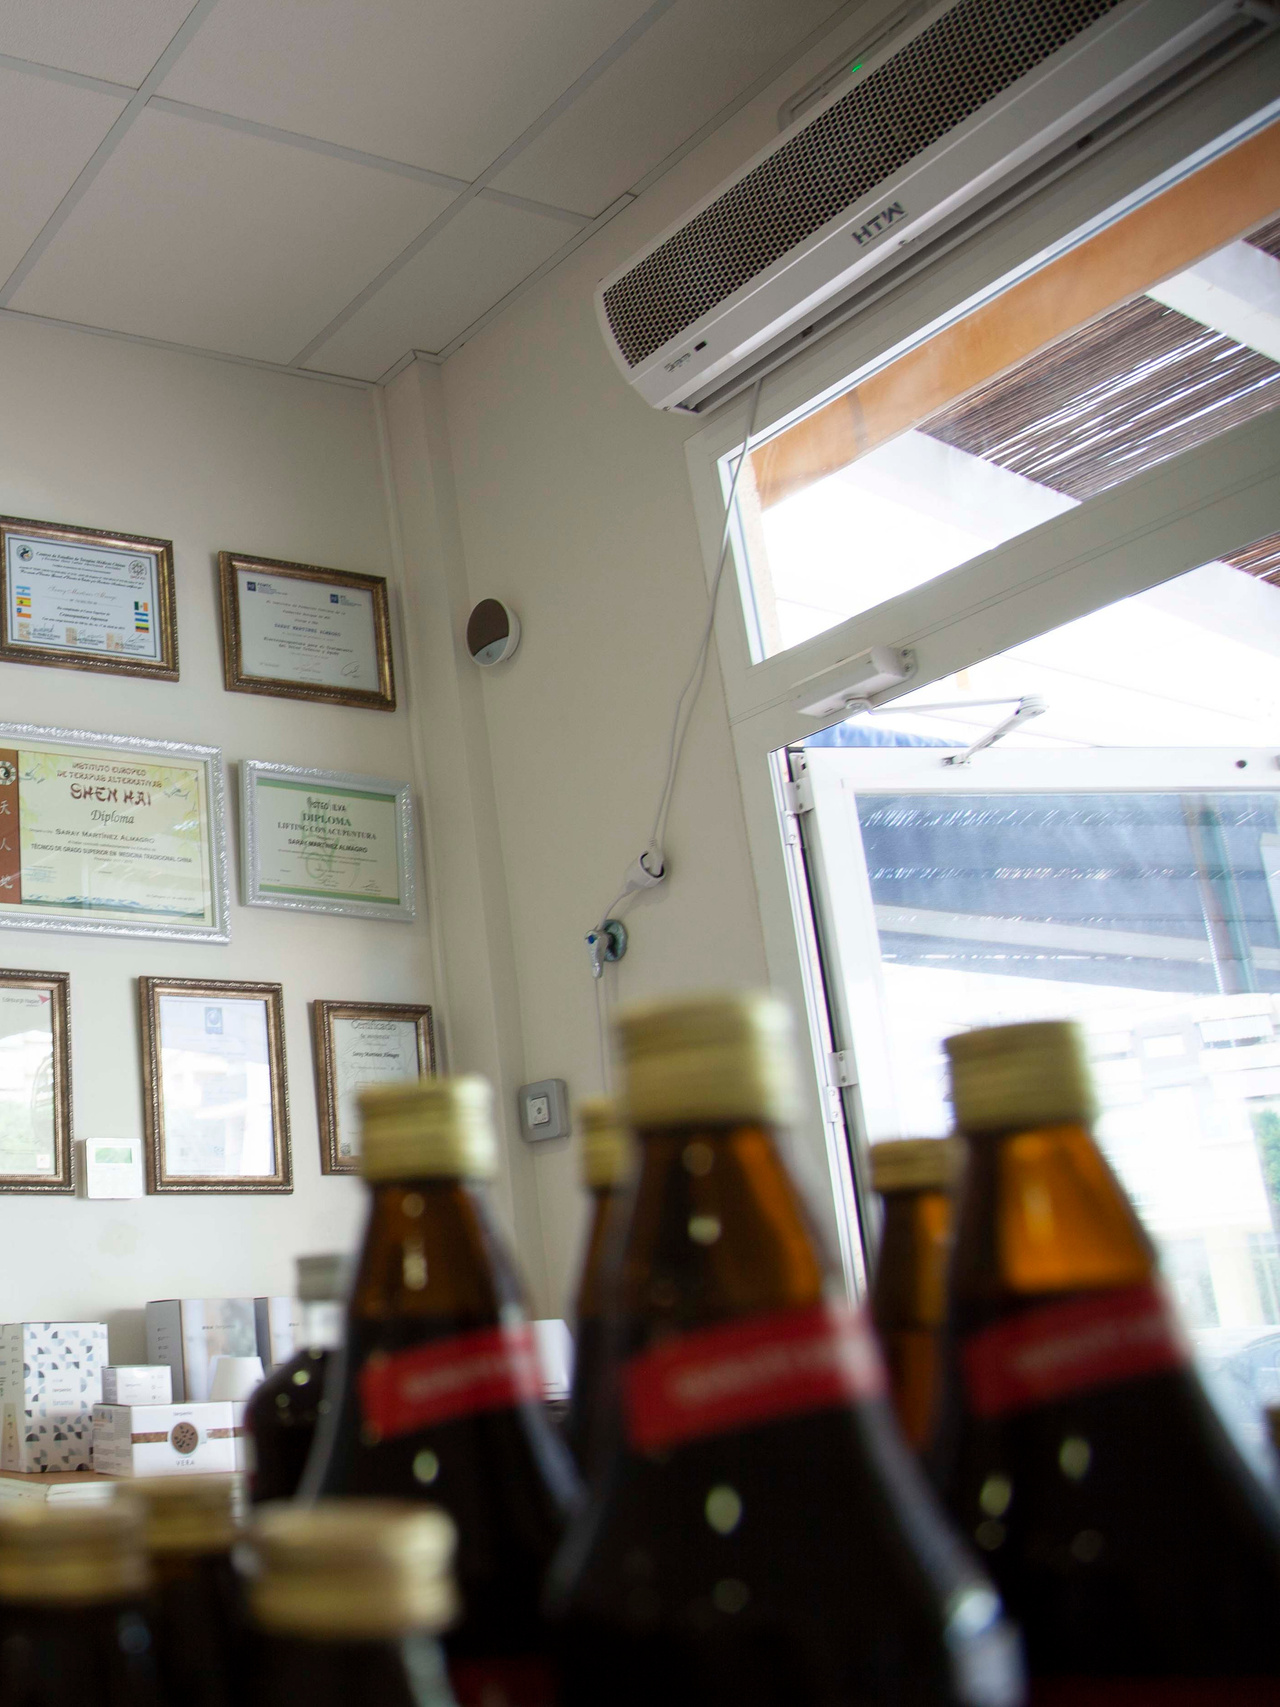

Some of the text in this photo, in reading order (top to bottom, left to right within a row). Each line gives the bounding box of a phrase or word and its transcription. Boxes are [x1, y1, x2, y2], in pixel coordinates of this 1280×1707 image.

[70, 782, 152, 807] SHEN HAI
[90, 809, 135, 826] Diploma
[302, 812, 352, 827] DIPLOMA
